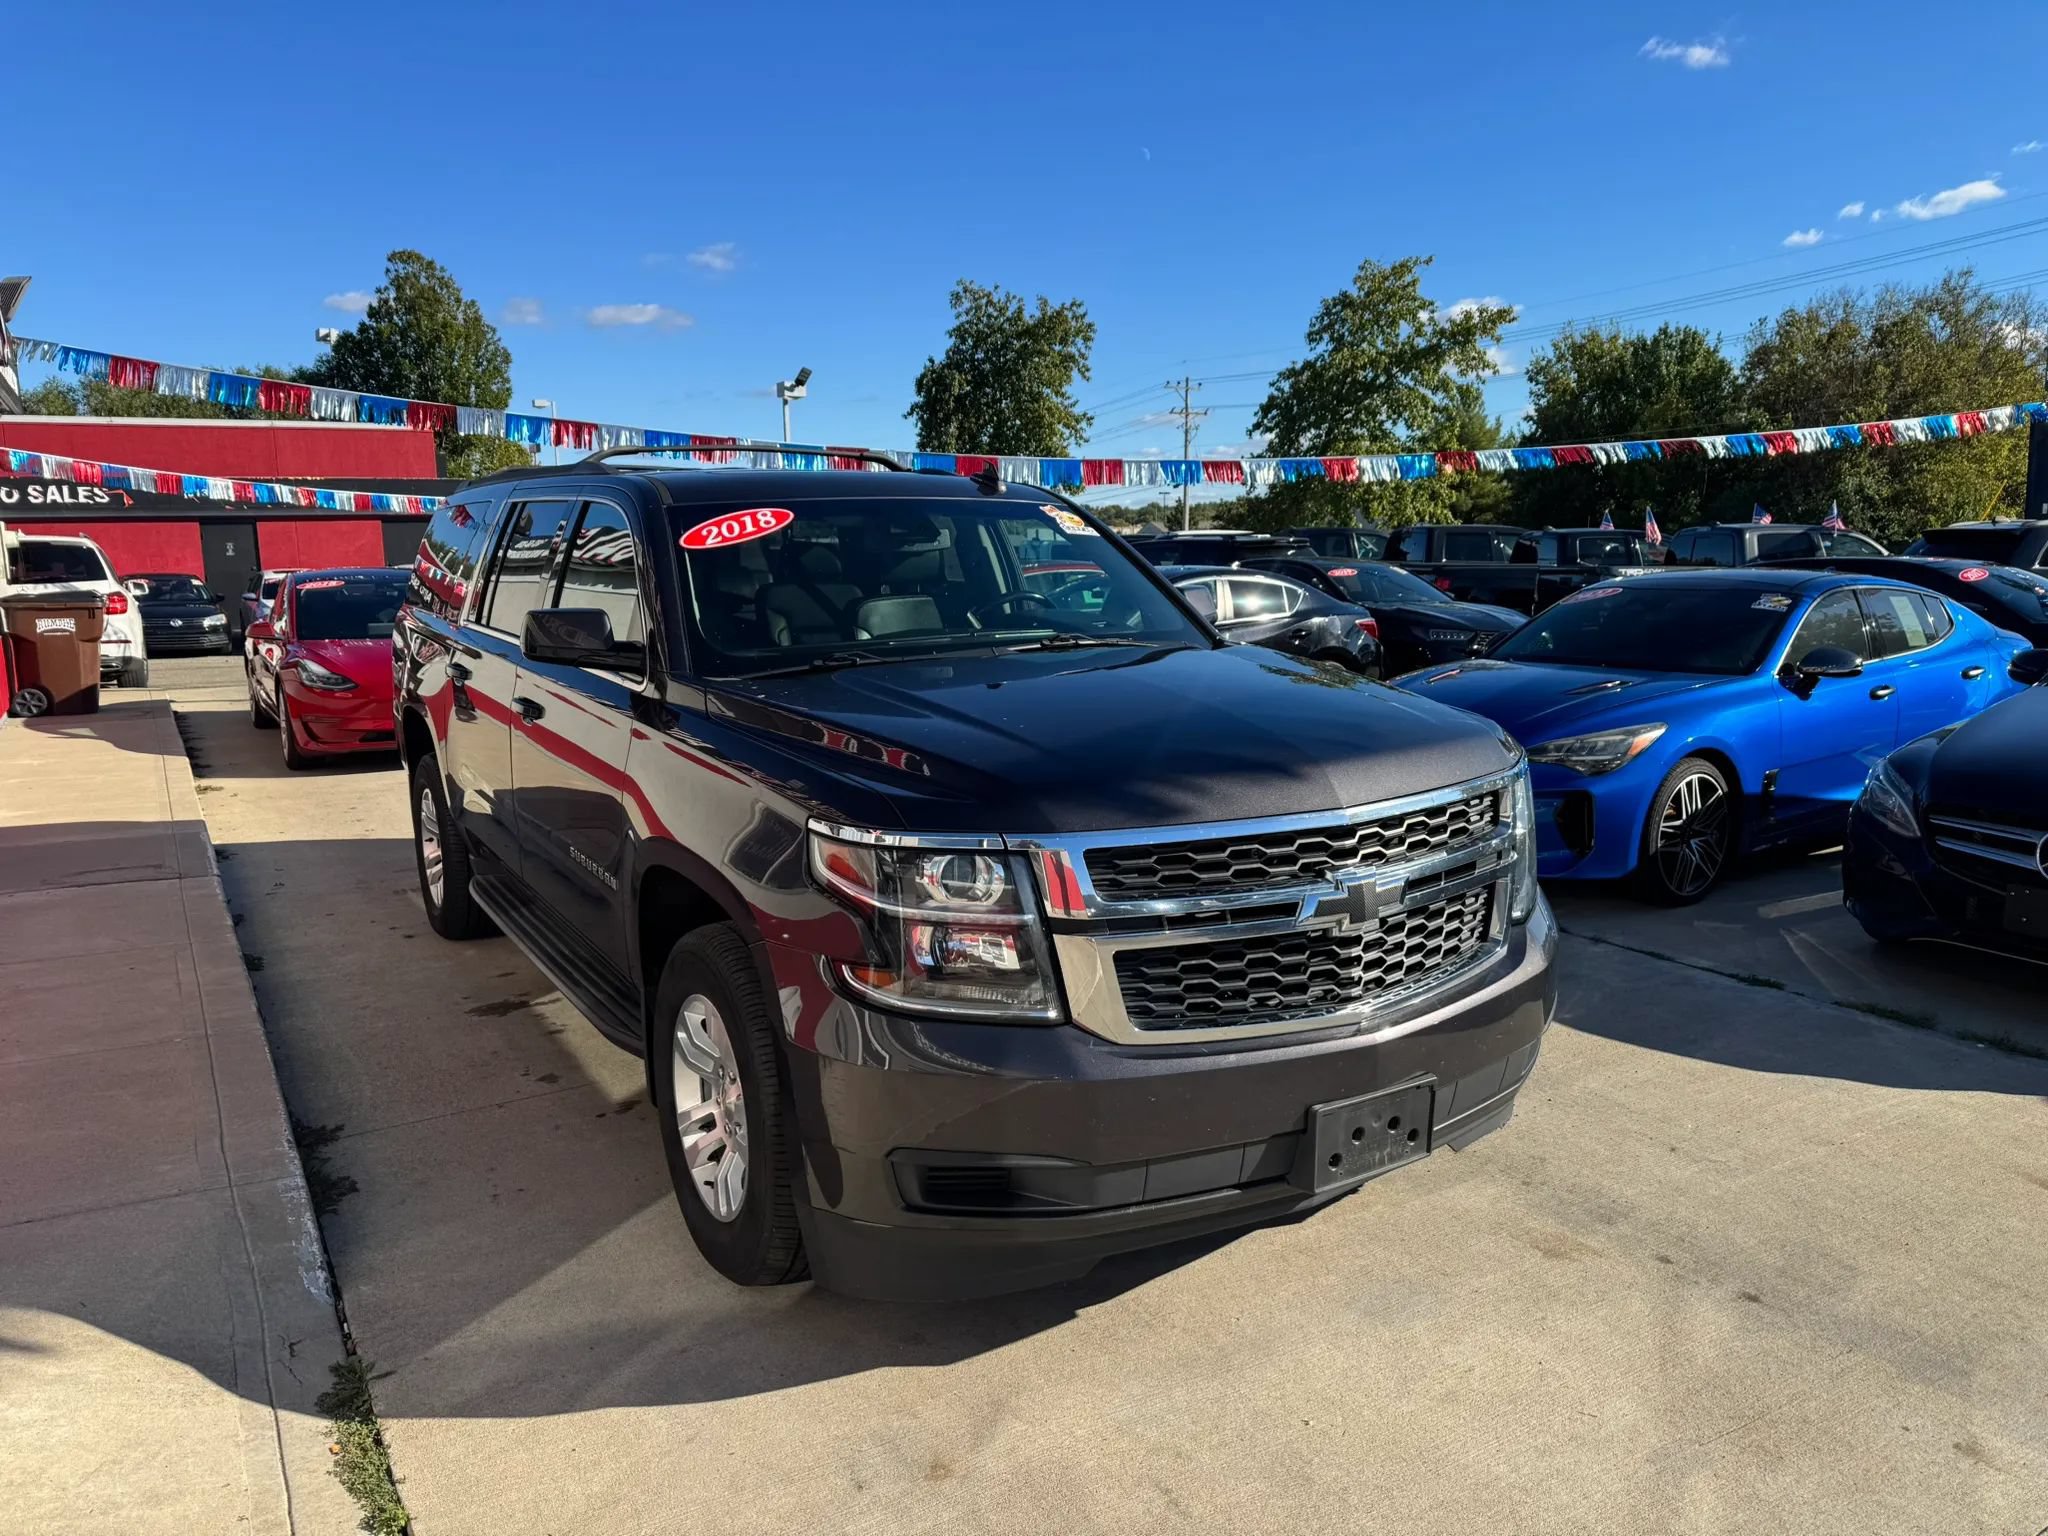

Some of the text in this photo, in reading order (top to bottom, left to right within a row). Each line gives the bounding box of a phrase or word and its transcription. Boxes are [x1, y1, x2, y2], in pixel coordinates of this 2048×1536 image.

[27, 485, 110, 504] SALES
[701, 510, 777, 545] 2018
[569, 846, 618, 891] SUBURBAN
